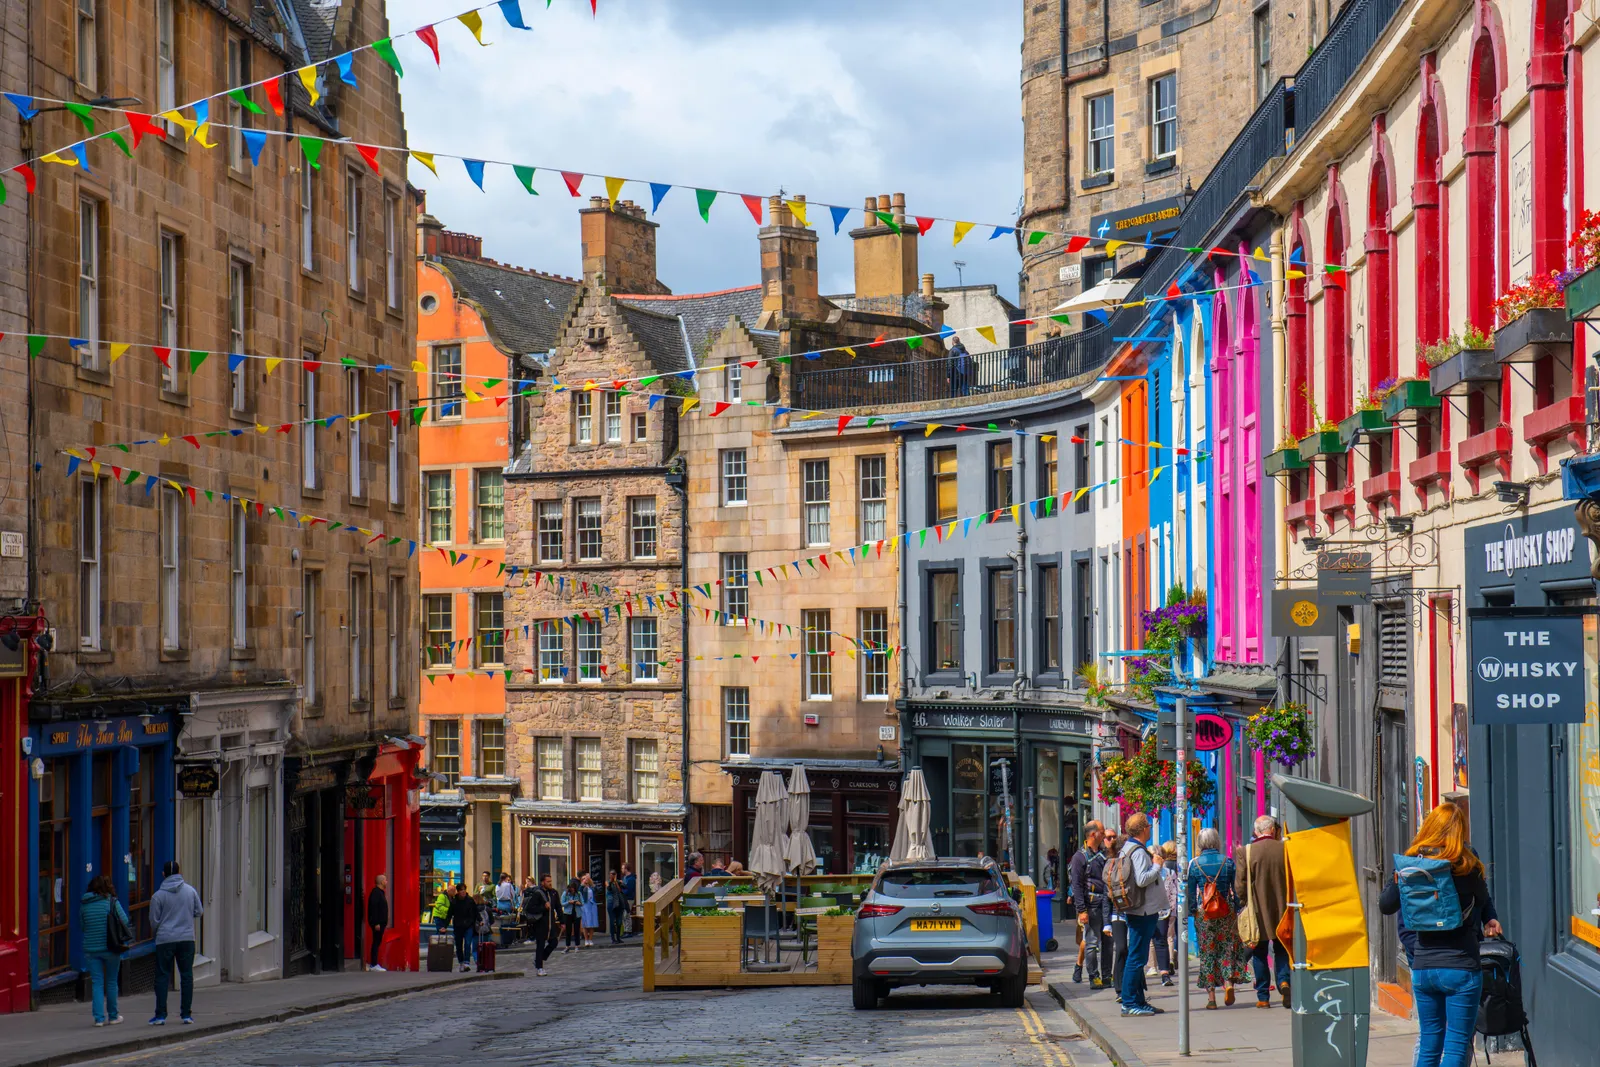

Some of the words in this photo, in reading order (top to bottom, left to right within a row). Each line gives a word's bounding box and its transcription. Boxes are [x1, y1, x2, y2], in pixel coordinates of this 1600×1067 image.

[2, 534, 22, 544] VICTORIA
[4, 546, 20, 556] STREET
[1485, 540, 1504, 572] THE
[1504, 531, 1543, 571] WHISKY
[1546, 527, 1575, 564] SHOP
[1503, 631, 1551, 646] THE
[1479, 660, 1578, 679] WHISKY
[1496, 693, 1561, 709] SHOP
[943, 714, 974, 727] Walker
[979, 714, 1006, 727] Slater
[51, 731, 69, 745] SPIRIT
[76, 723, 92, 749] The
[117, 719, 133, 743] Bar
[849, 781, 879, 789] CLARKSONS
[521, 817, 533, 826] 89
[670, 822, 683, 832] 89
[916, 920, 937, 930] MA71
[939, 920, 956, 929] YYN
